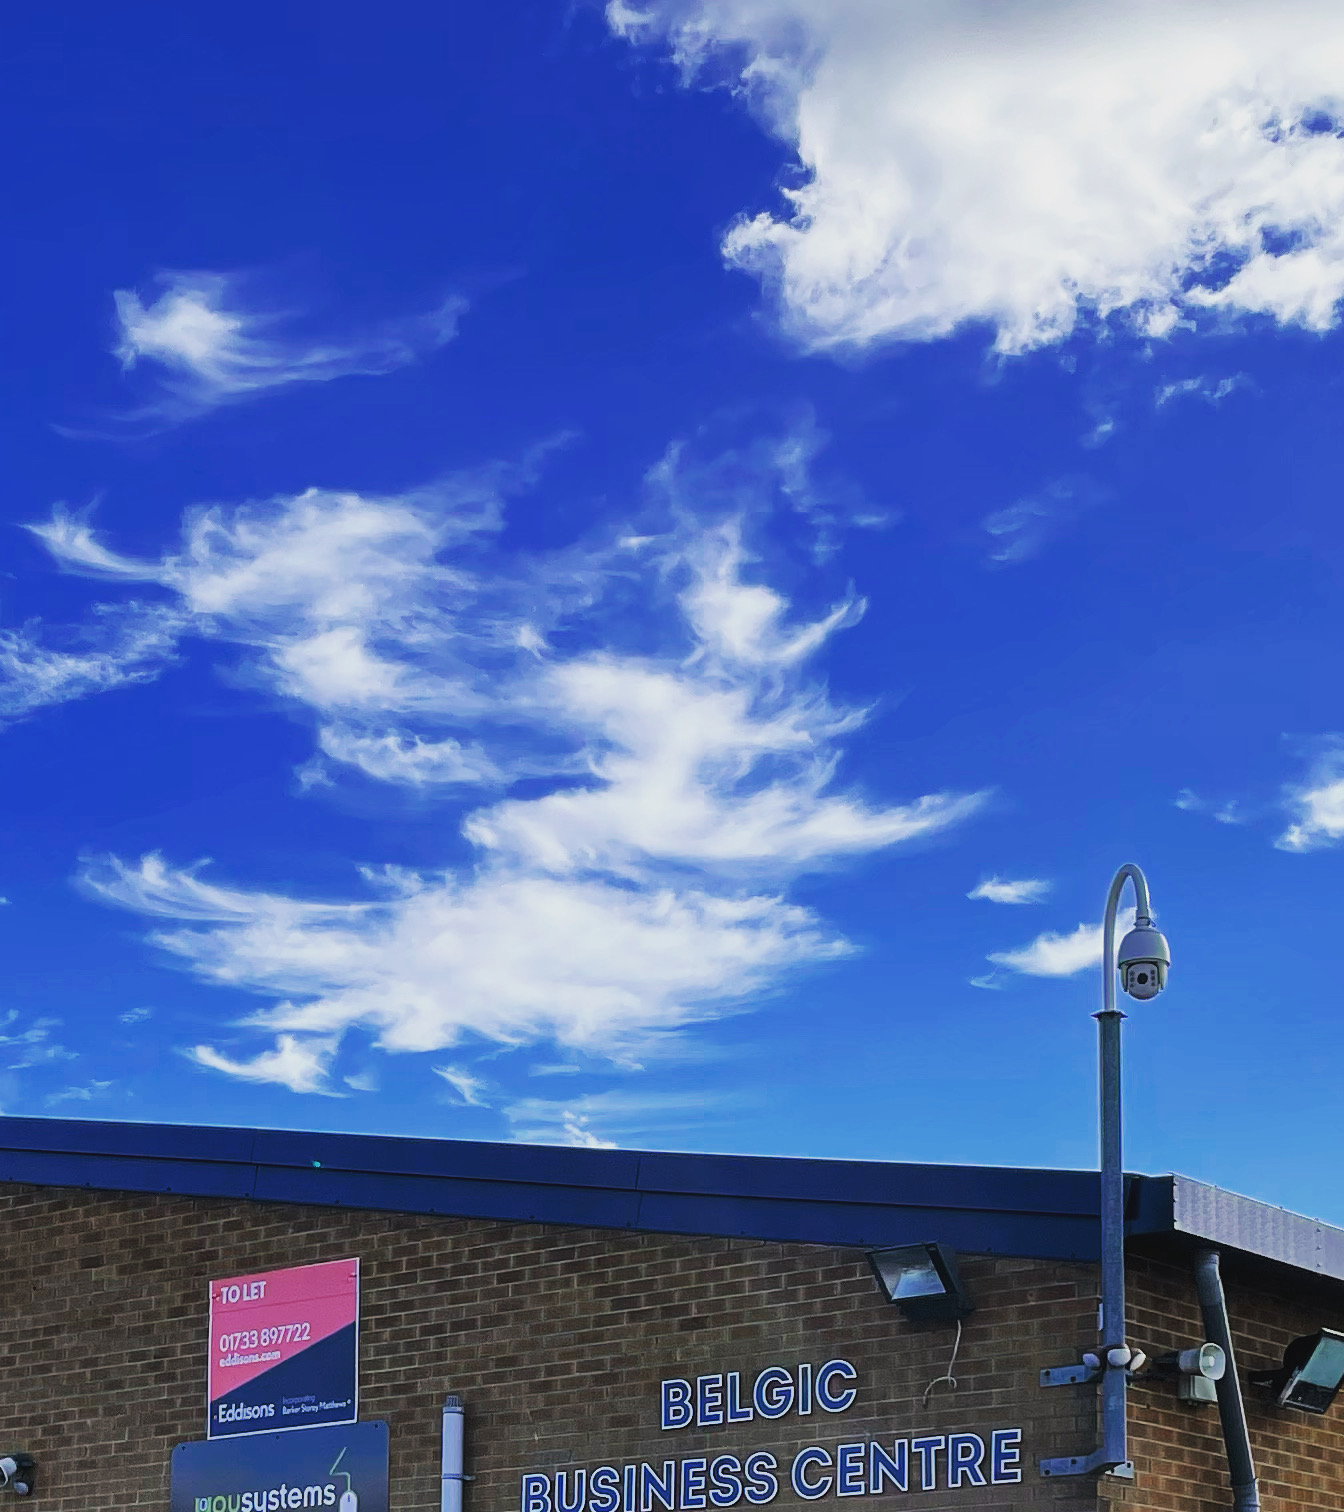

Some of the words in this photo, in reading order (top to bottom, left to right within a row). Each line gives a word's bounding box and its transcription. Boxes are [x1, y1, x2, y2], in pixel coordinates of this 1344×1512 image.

[221, 1285, 240, 1304] TO
[243, 1281, 266, 1301] LET
[219, 1330, 258, 1352] 01733
[260, 1322, 311, 1347] 897722
[219, 1350, 281, 1367] eddisons.com
[661, 1359, 857, 1430] BELGIC
[218, 1402, 275, 1423] Eddisons
[791, 1428, 1022, 1500] CENTRE
